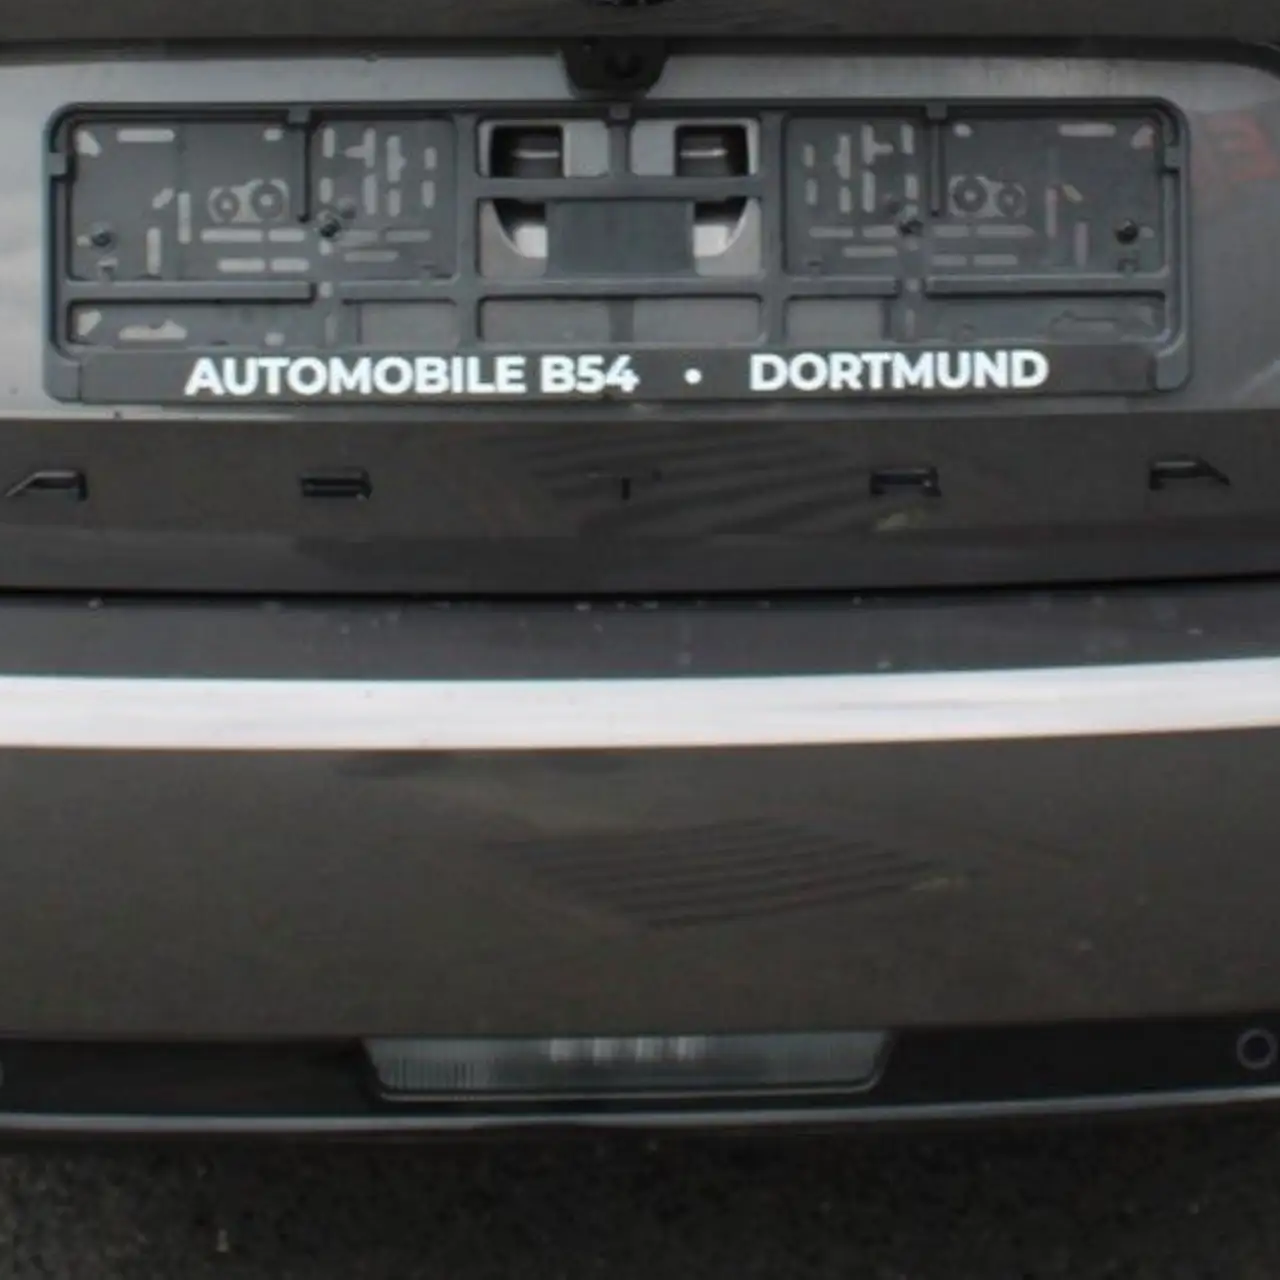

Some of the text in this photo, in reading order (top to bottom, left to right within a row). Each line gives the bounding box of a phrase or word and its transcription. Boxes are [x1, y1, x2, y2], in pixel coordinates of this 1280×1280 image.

[184, 349, 1050, 396] AUTOMOBILE B54 DORTMUND
